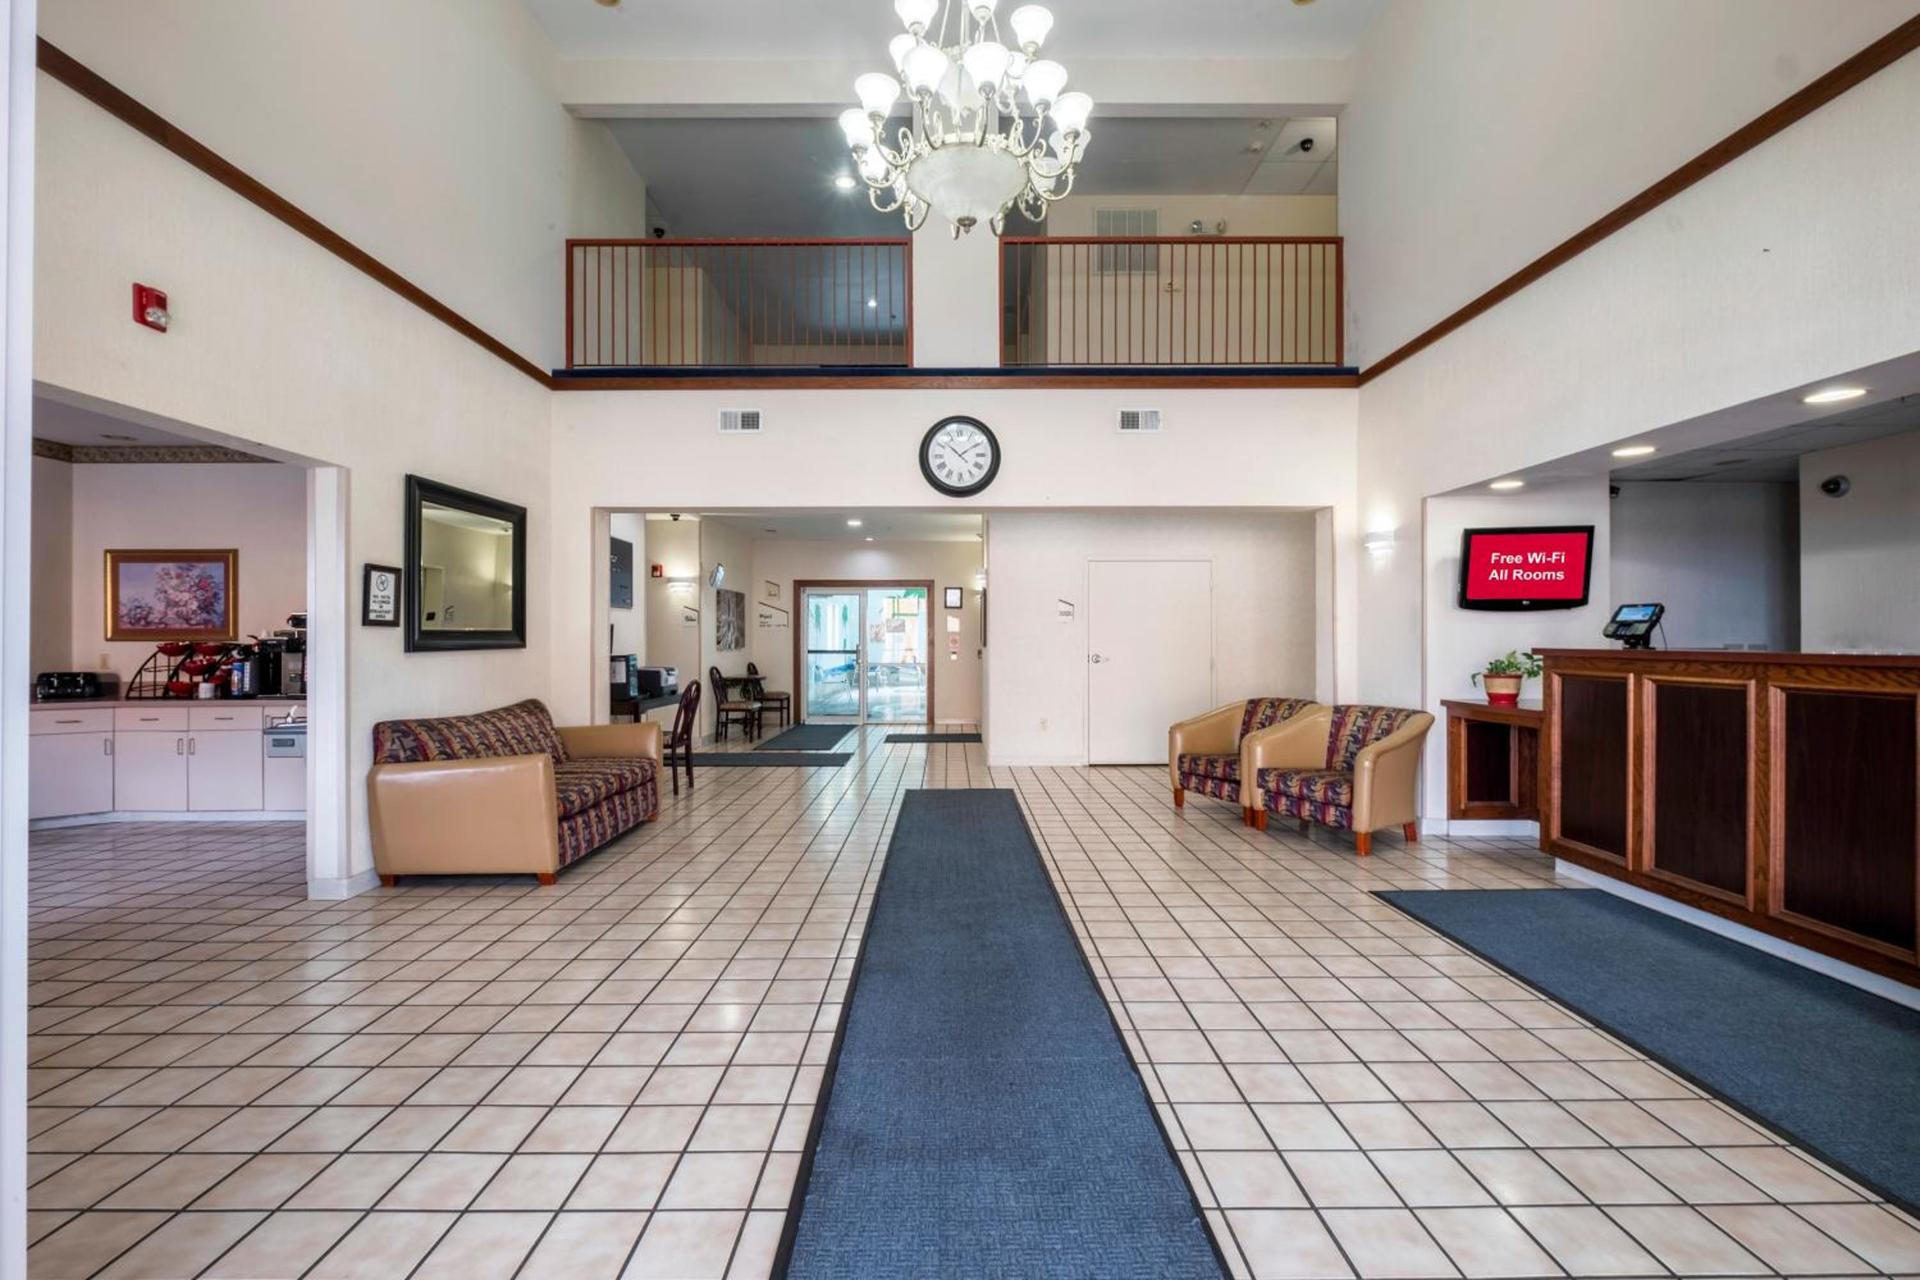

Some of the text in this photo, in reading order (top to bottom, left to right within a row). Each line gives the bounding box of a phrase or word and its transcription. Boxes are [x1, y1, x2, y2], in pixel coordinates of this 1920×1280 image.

[1490, 551, 1566, 564] Free Wi-Fi
[1488, 568, 1565, 581] All Rooms
